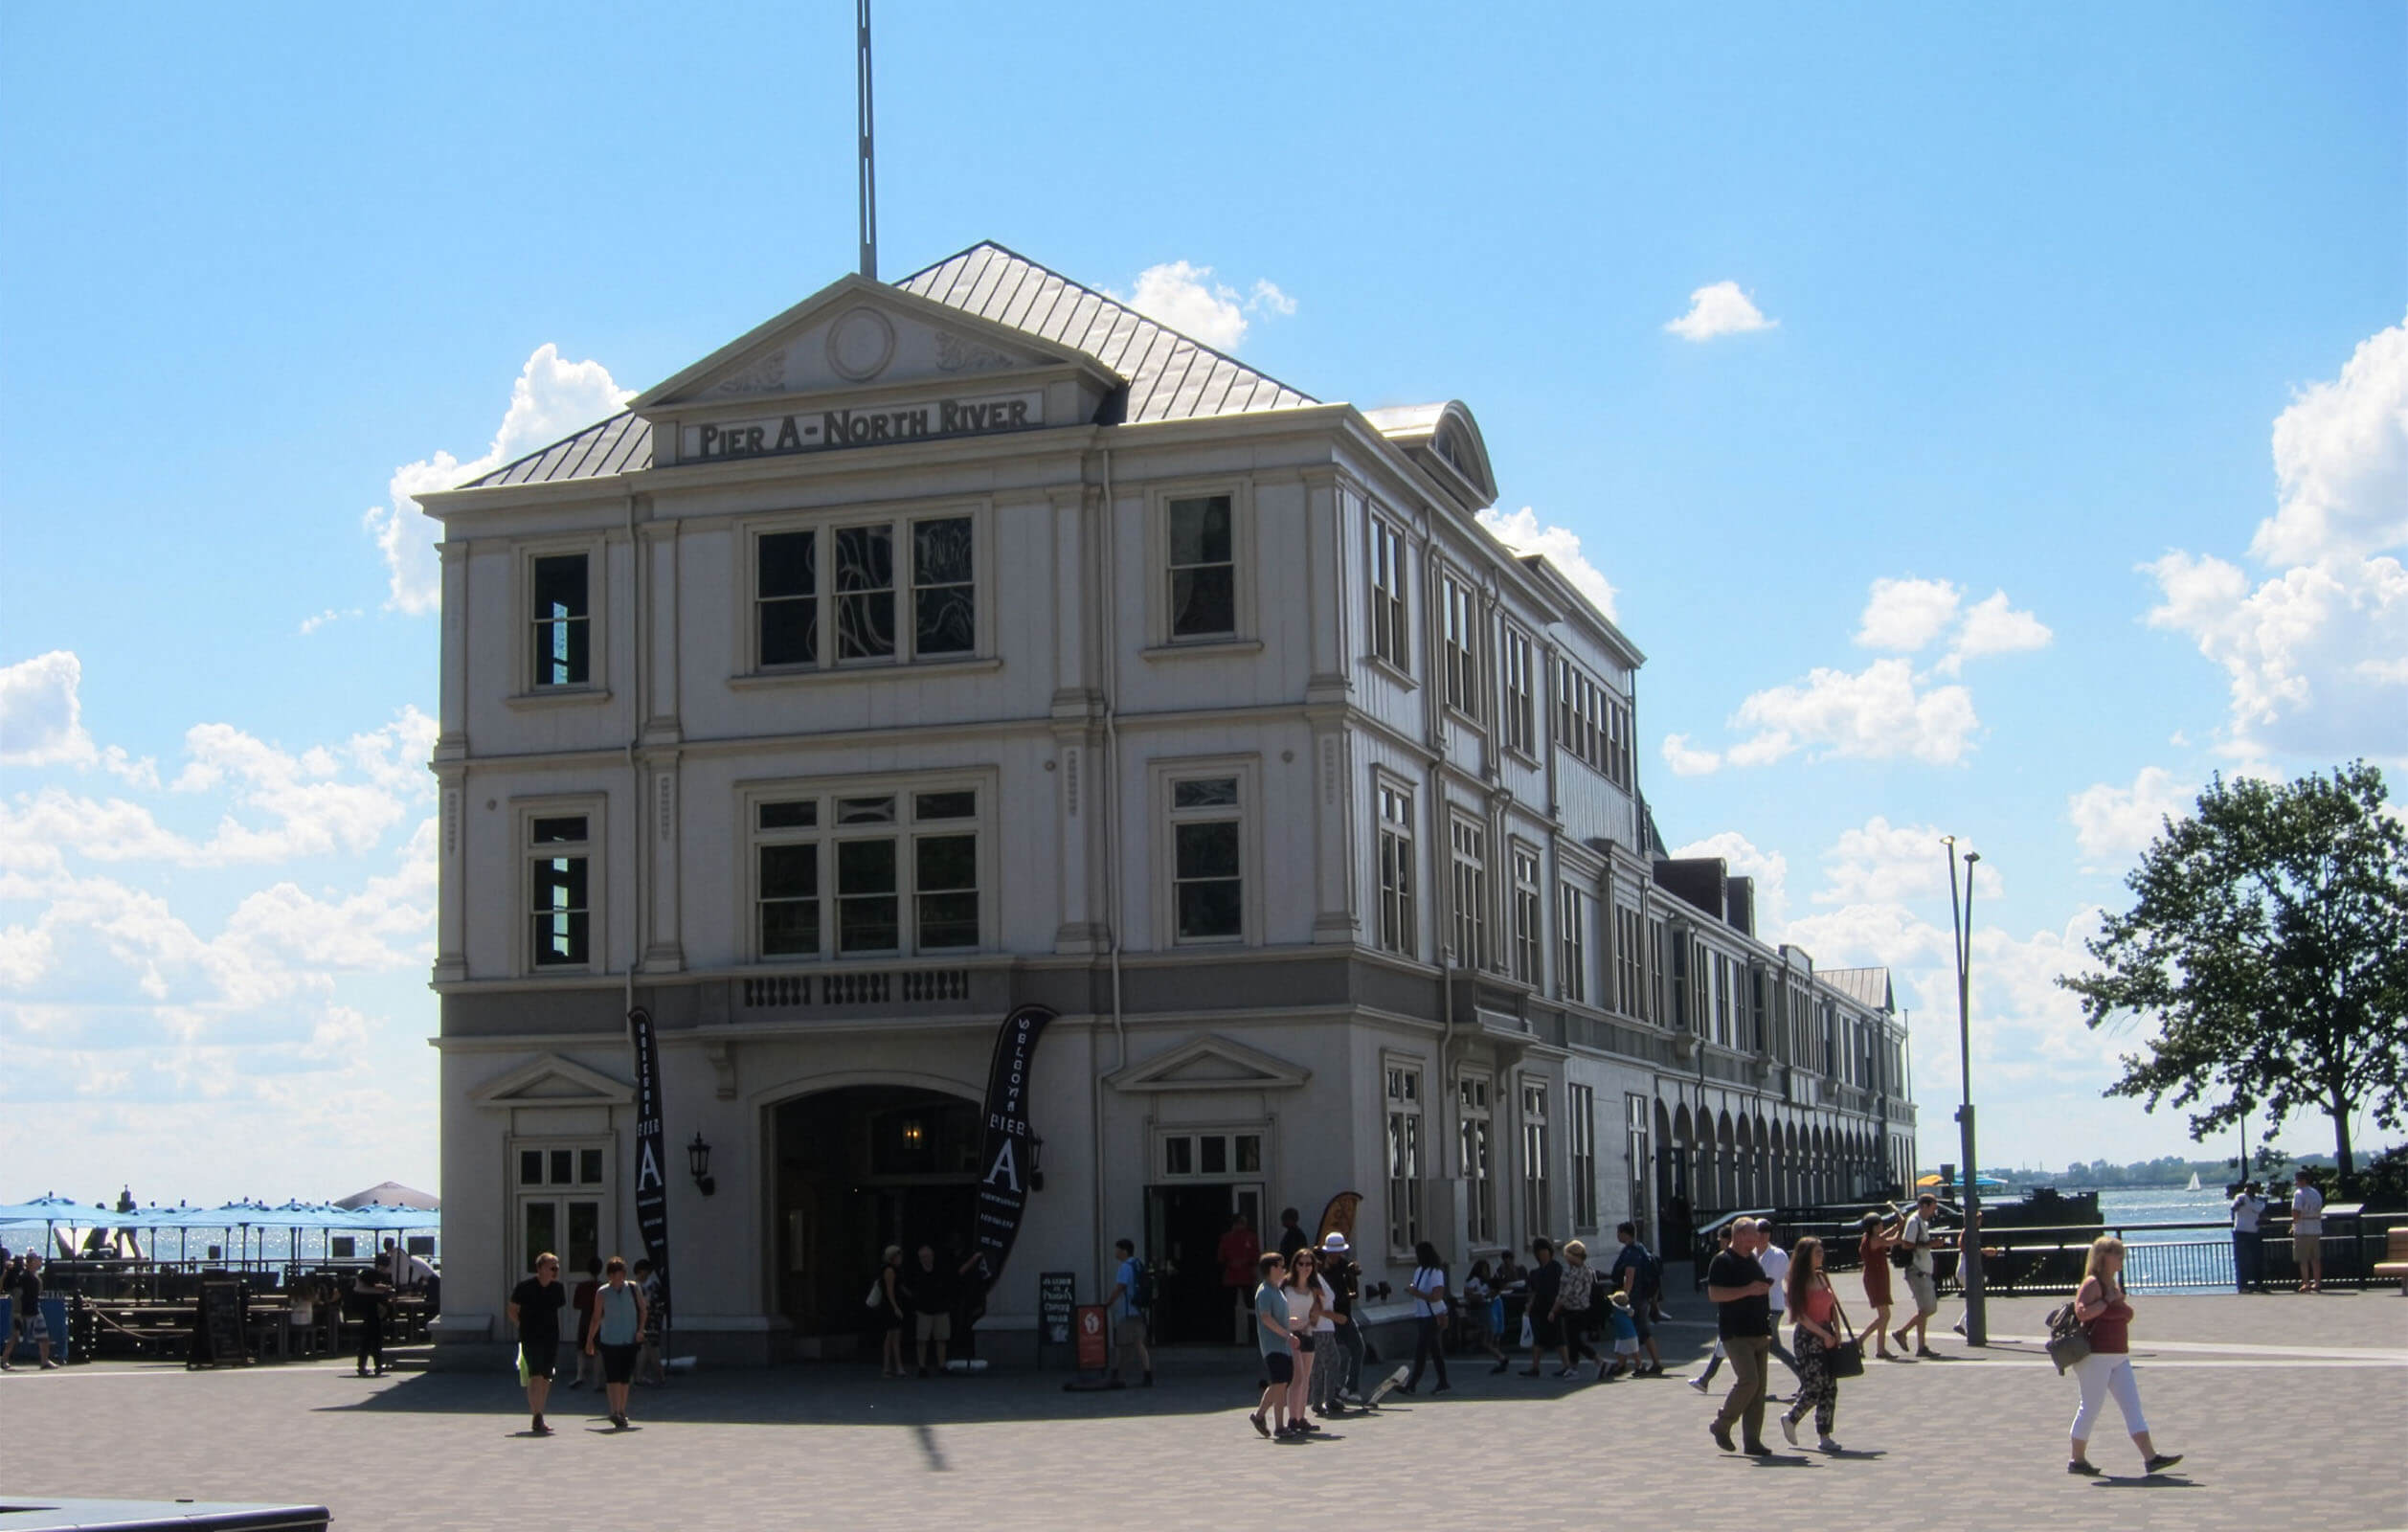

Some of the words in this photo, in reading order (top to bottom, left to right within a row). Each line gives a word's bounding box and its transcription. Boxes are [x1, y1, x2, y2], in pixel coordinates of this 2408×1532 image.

[699, 423, 766, 458] PIER
[937, 398, 1029, 433] RIVER
[637, 1139, 664, 1192] A
[982, 1138, 1023, 1194] A
